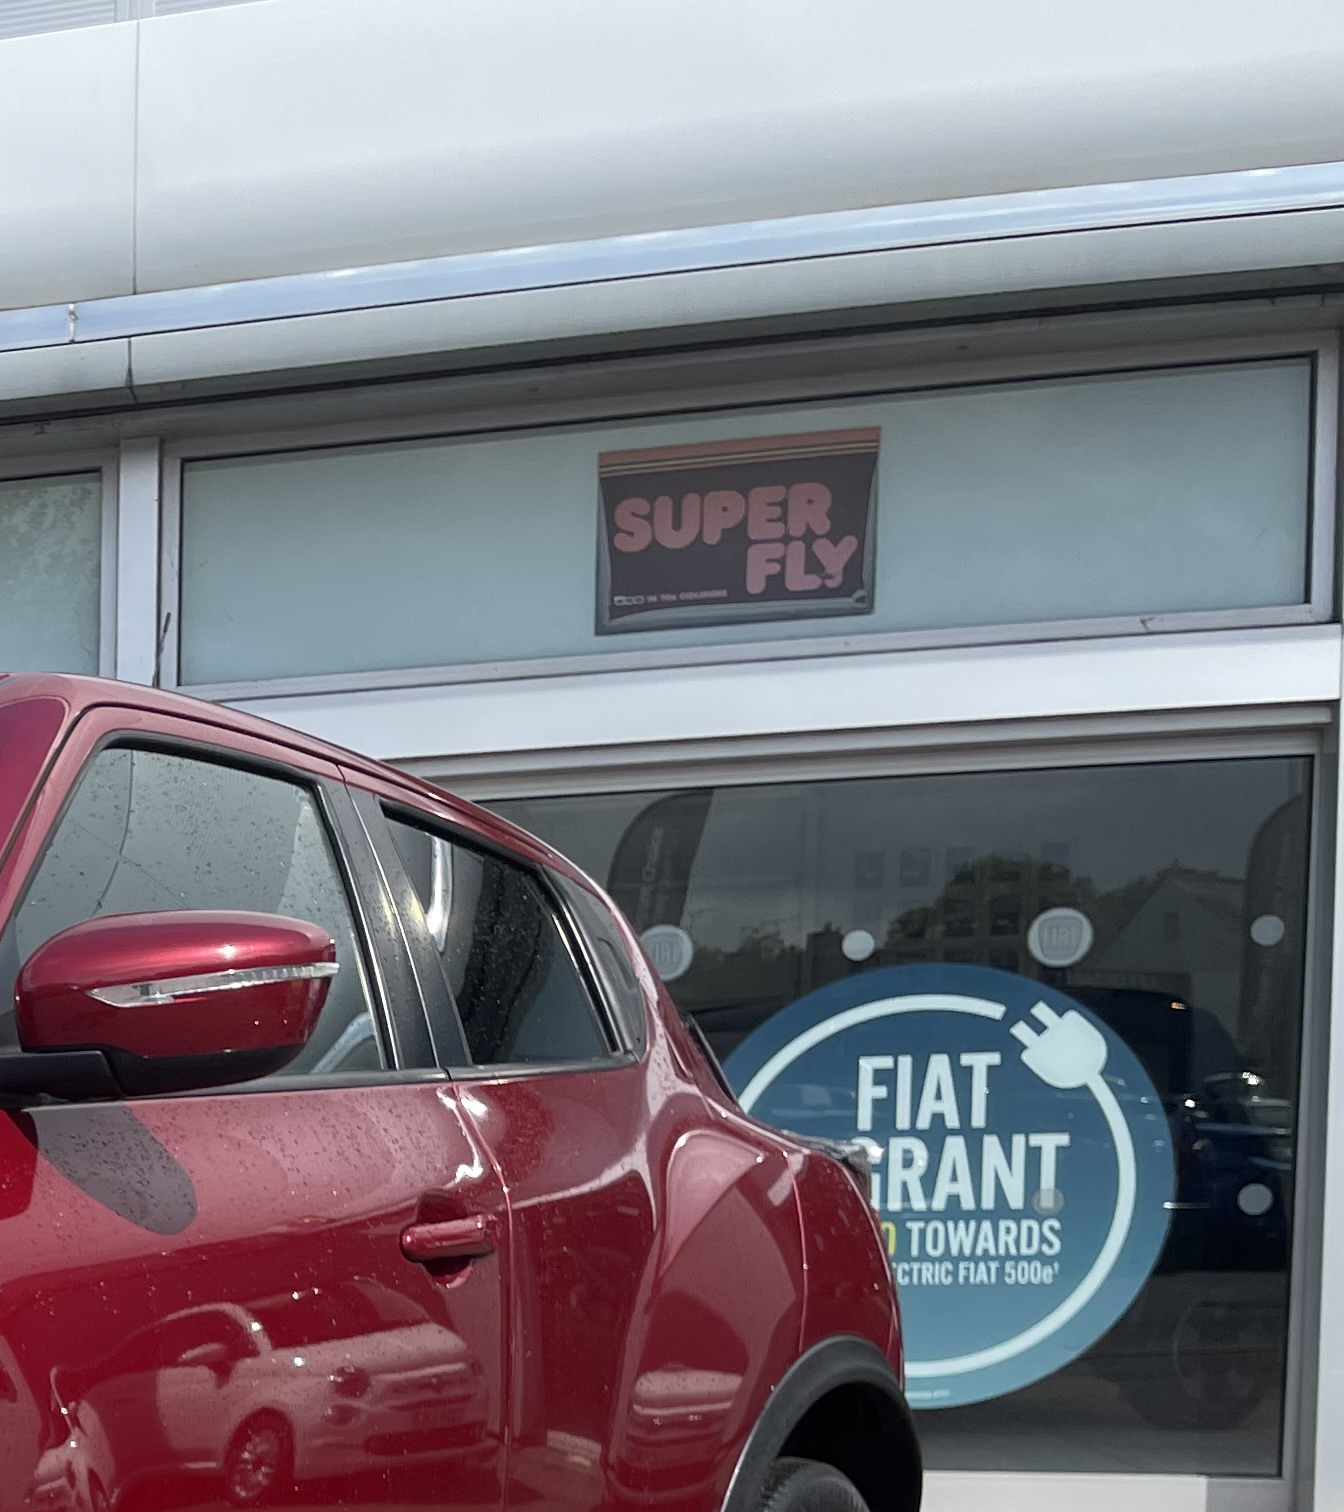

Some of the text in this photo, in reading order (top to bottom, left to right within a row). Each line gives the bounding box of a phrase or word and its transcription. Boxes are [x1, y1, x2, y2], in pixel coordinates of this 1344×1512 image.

[614, 482, 832, 552] SUPER
[746, 535, 858, 594] FLY
[857, 1052, 1001, 1131] FIAT
[905, 1218, 1062, 1257] TOWARDS
[958, 1260, 1000, 1285] FIAT
